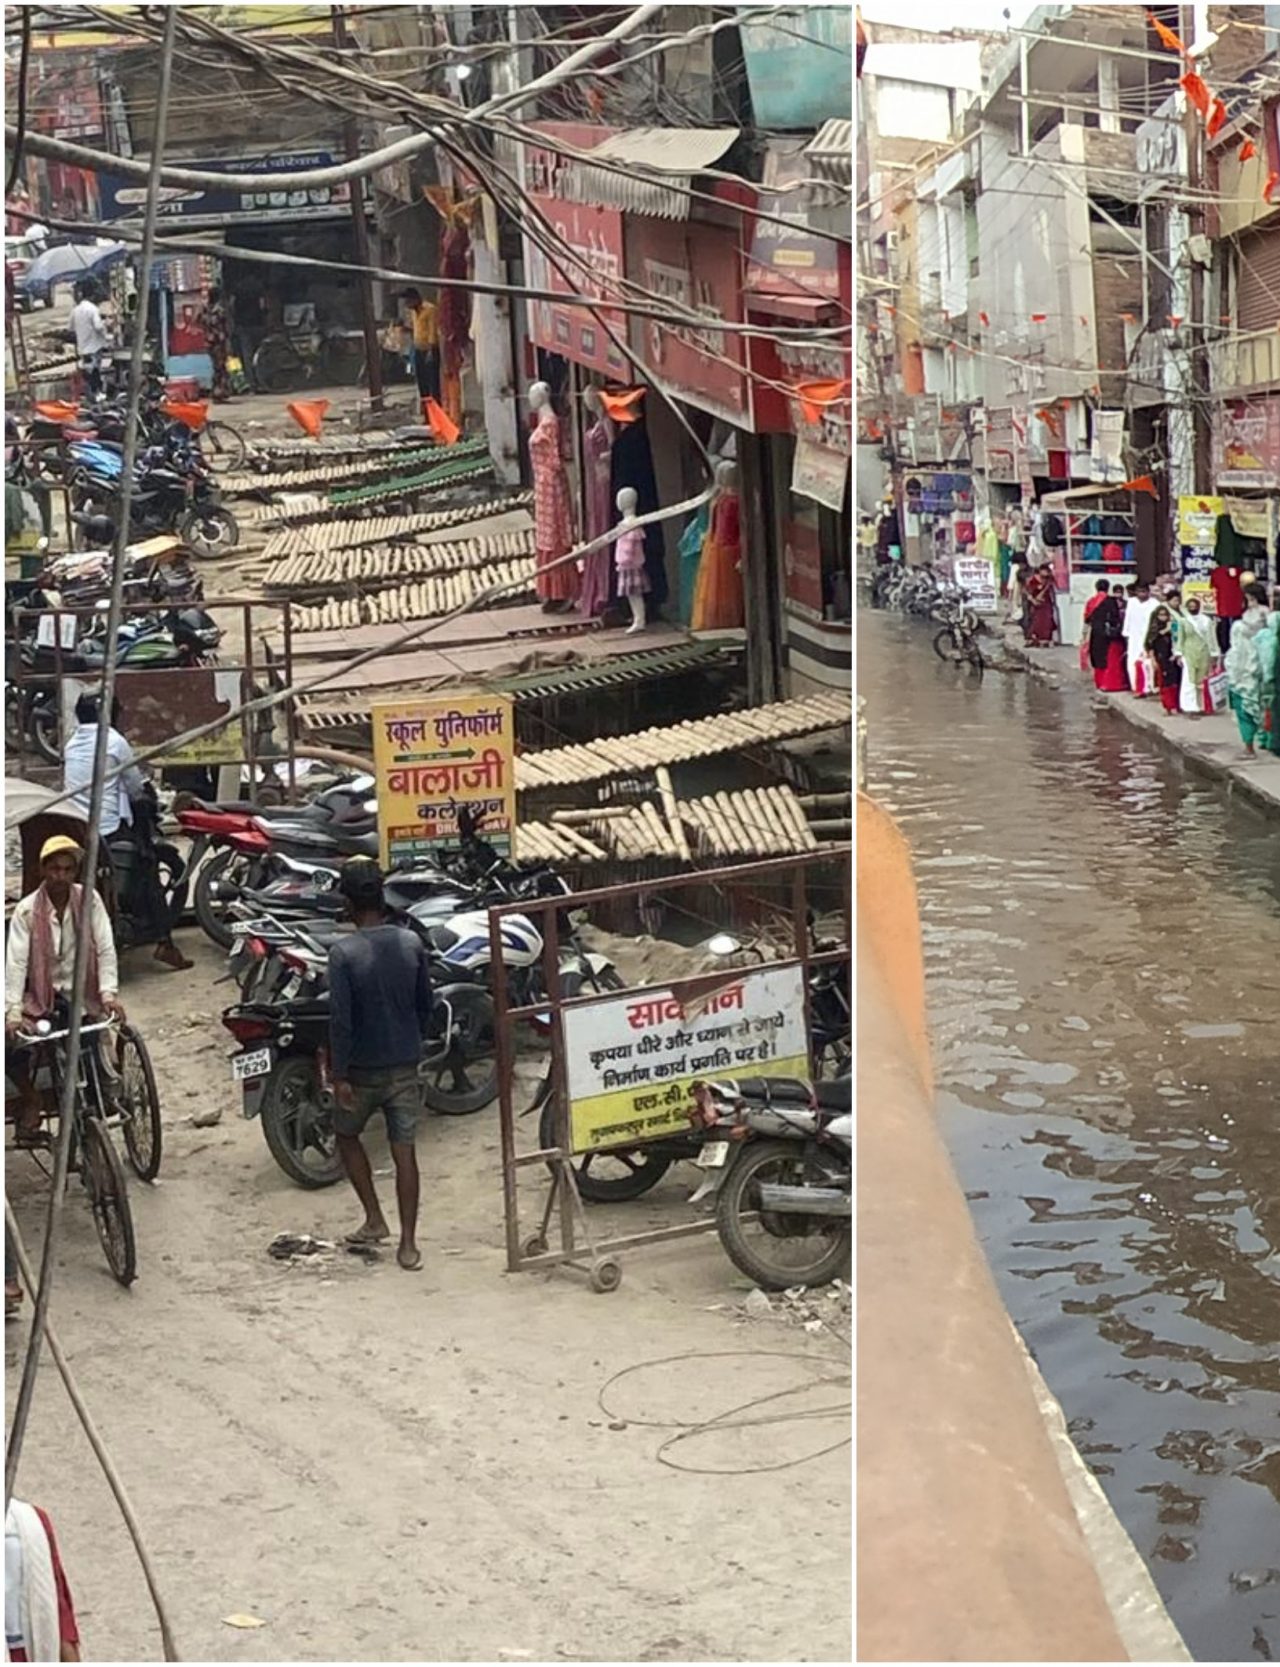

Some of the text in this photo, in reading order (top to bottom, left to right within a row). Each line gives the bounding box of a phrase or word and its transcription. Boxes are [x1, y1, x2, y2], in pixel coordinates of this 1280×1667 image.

[385, 719, 427, 750] स्कूल
[386, 749, 505, 795] बालाजी
[636, 1034, 662, 1054] धीरे
[665, 1028, 694, 1052] और
[237, 1059, 268, 1076] 7629
[654, 1055, 687, 1079] कार्य
[690, 1048, 732, 1074] प्रगति
[735, 1046, 756, 1064] पर
